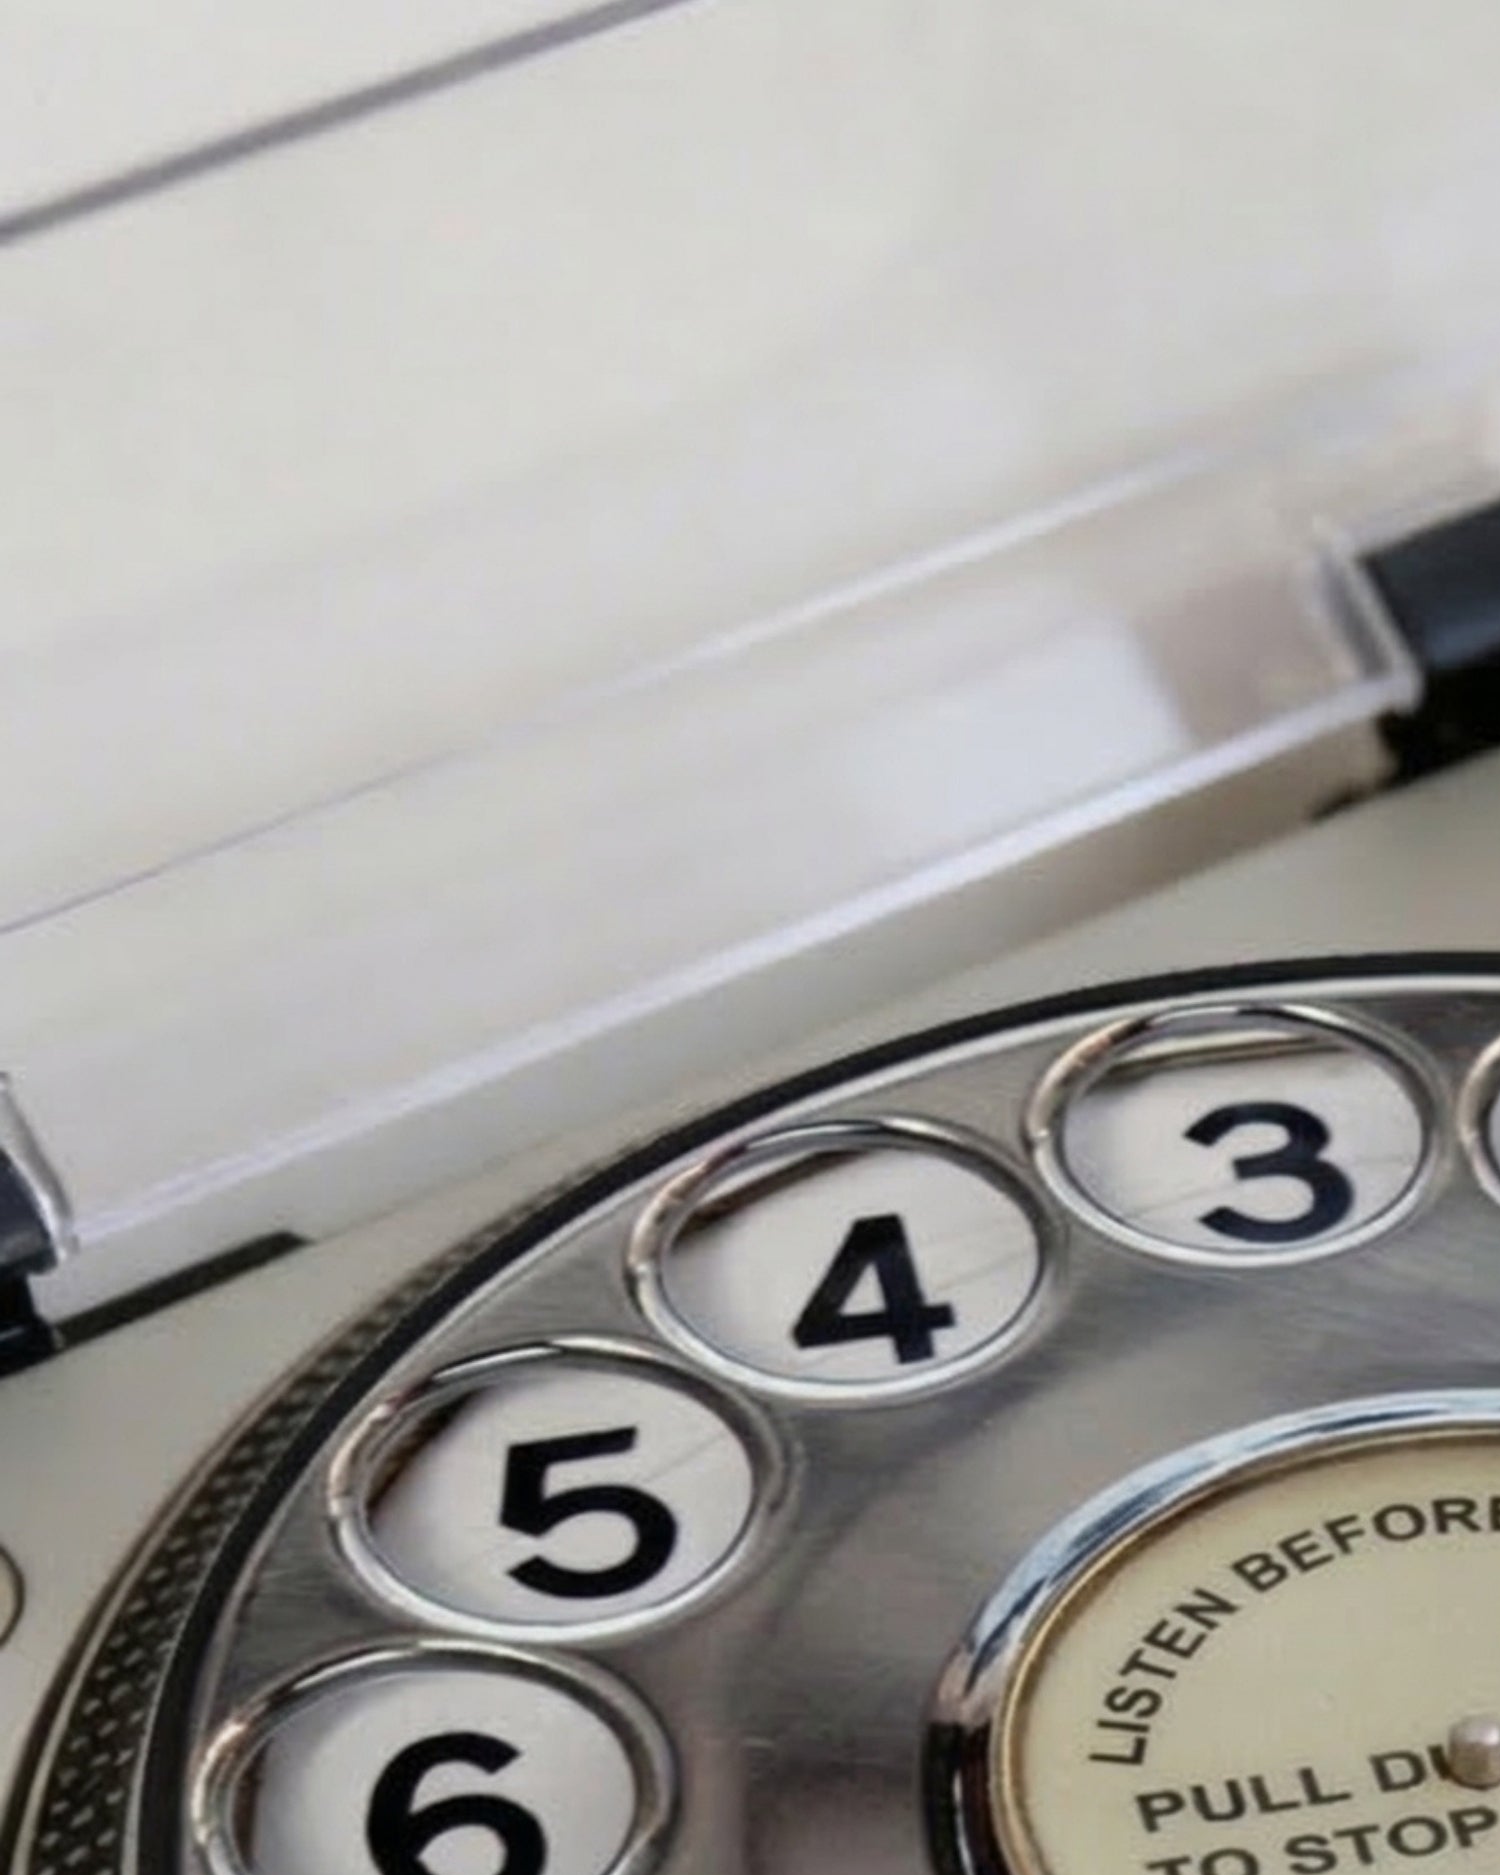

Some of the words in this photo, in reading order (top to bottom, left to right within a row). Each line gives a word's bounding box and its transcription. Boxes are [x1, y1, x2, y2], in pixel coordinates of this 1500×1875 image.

[1186, 1103, 1352, 1242] 3
[793, 1214, 954, 1364] 4
[500, 1427, 677, 1599] 5
[1087, 1588, 1241, 1767] LISTEN
[1133, 1767, 1354, 1835] PULL
